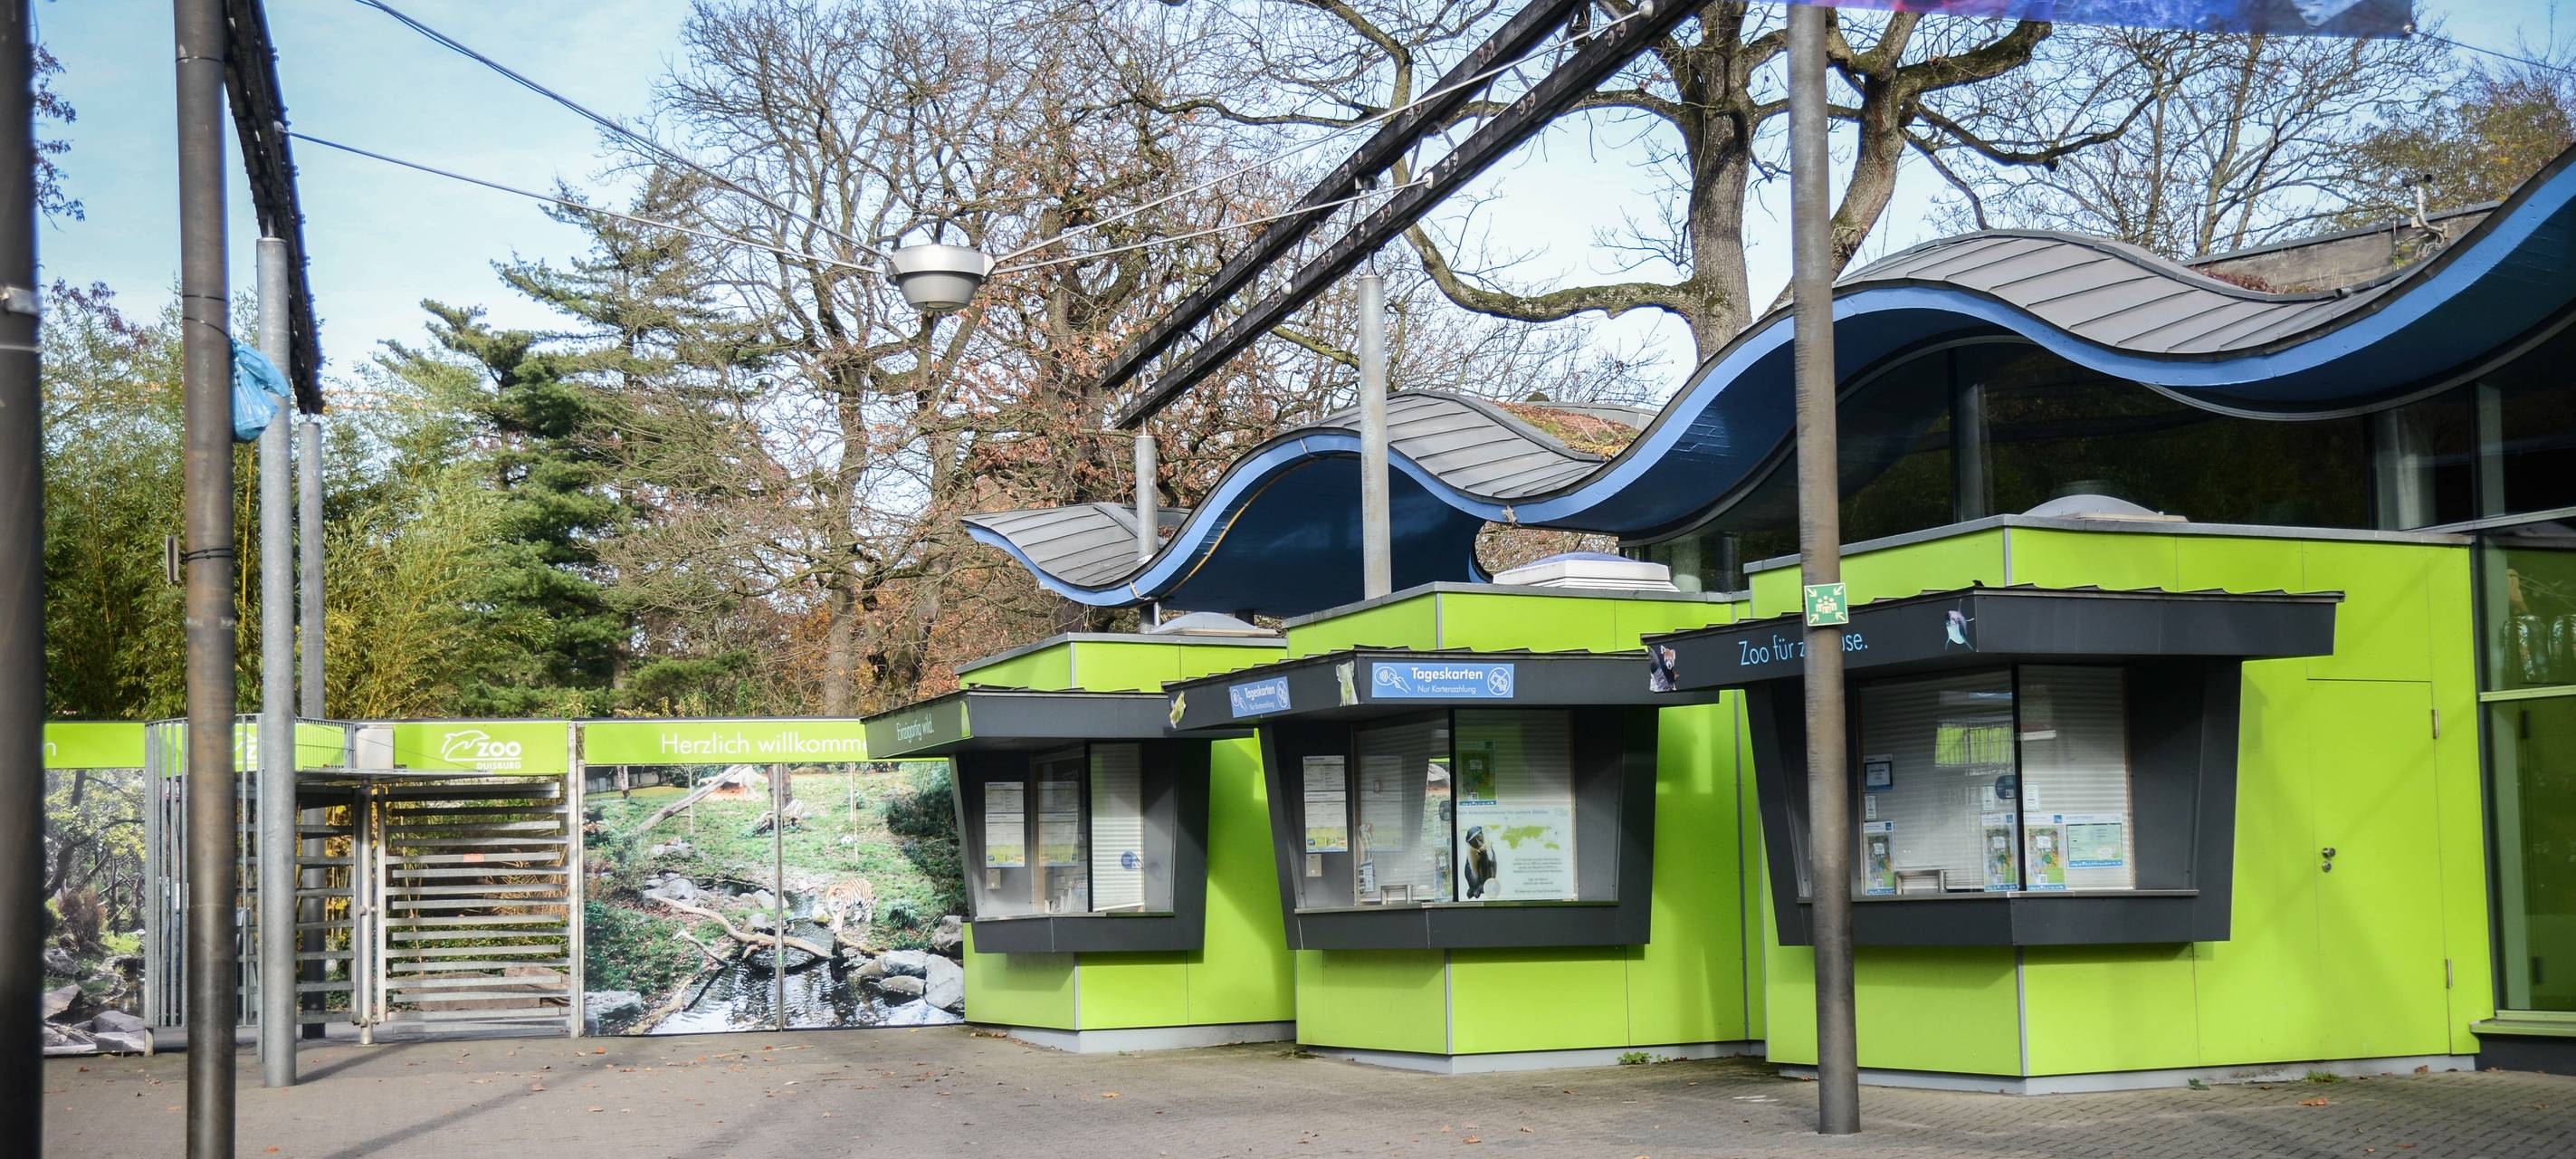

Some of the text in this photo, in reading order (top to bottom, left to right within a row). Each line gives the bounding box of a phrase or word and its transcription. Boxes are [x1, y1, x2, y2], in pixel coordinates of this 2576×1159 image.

[1738, 640, 1770, 666] Zoo
[1772, 634, 1794, 661] für
[1411, 667, 1484, 683] Tageskarten
[1245, 685, 1275, 701] Tageskarten
[1417, 684, 1476, 695] Nur Kartenzahlung
[477, 741, 522, 757] ZOO
[662, 732, 749, 754] Herzlich
[477, 761, 522, 770] DUISBURG
